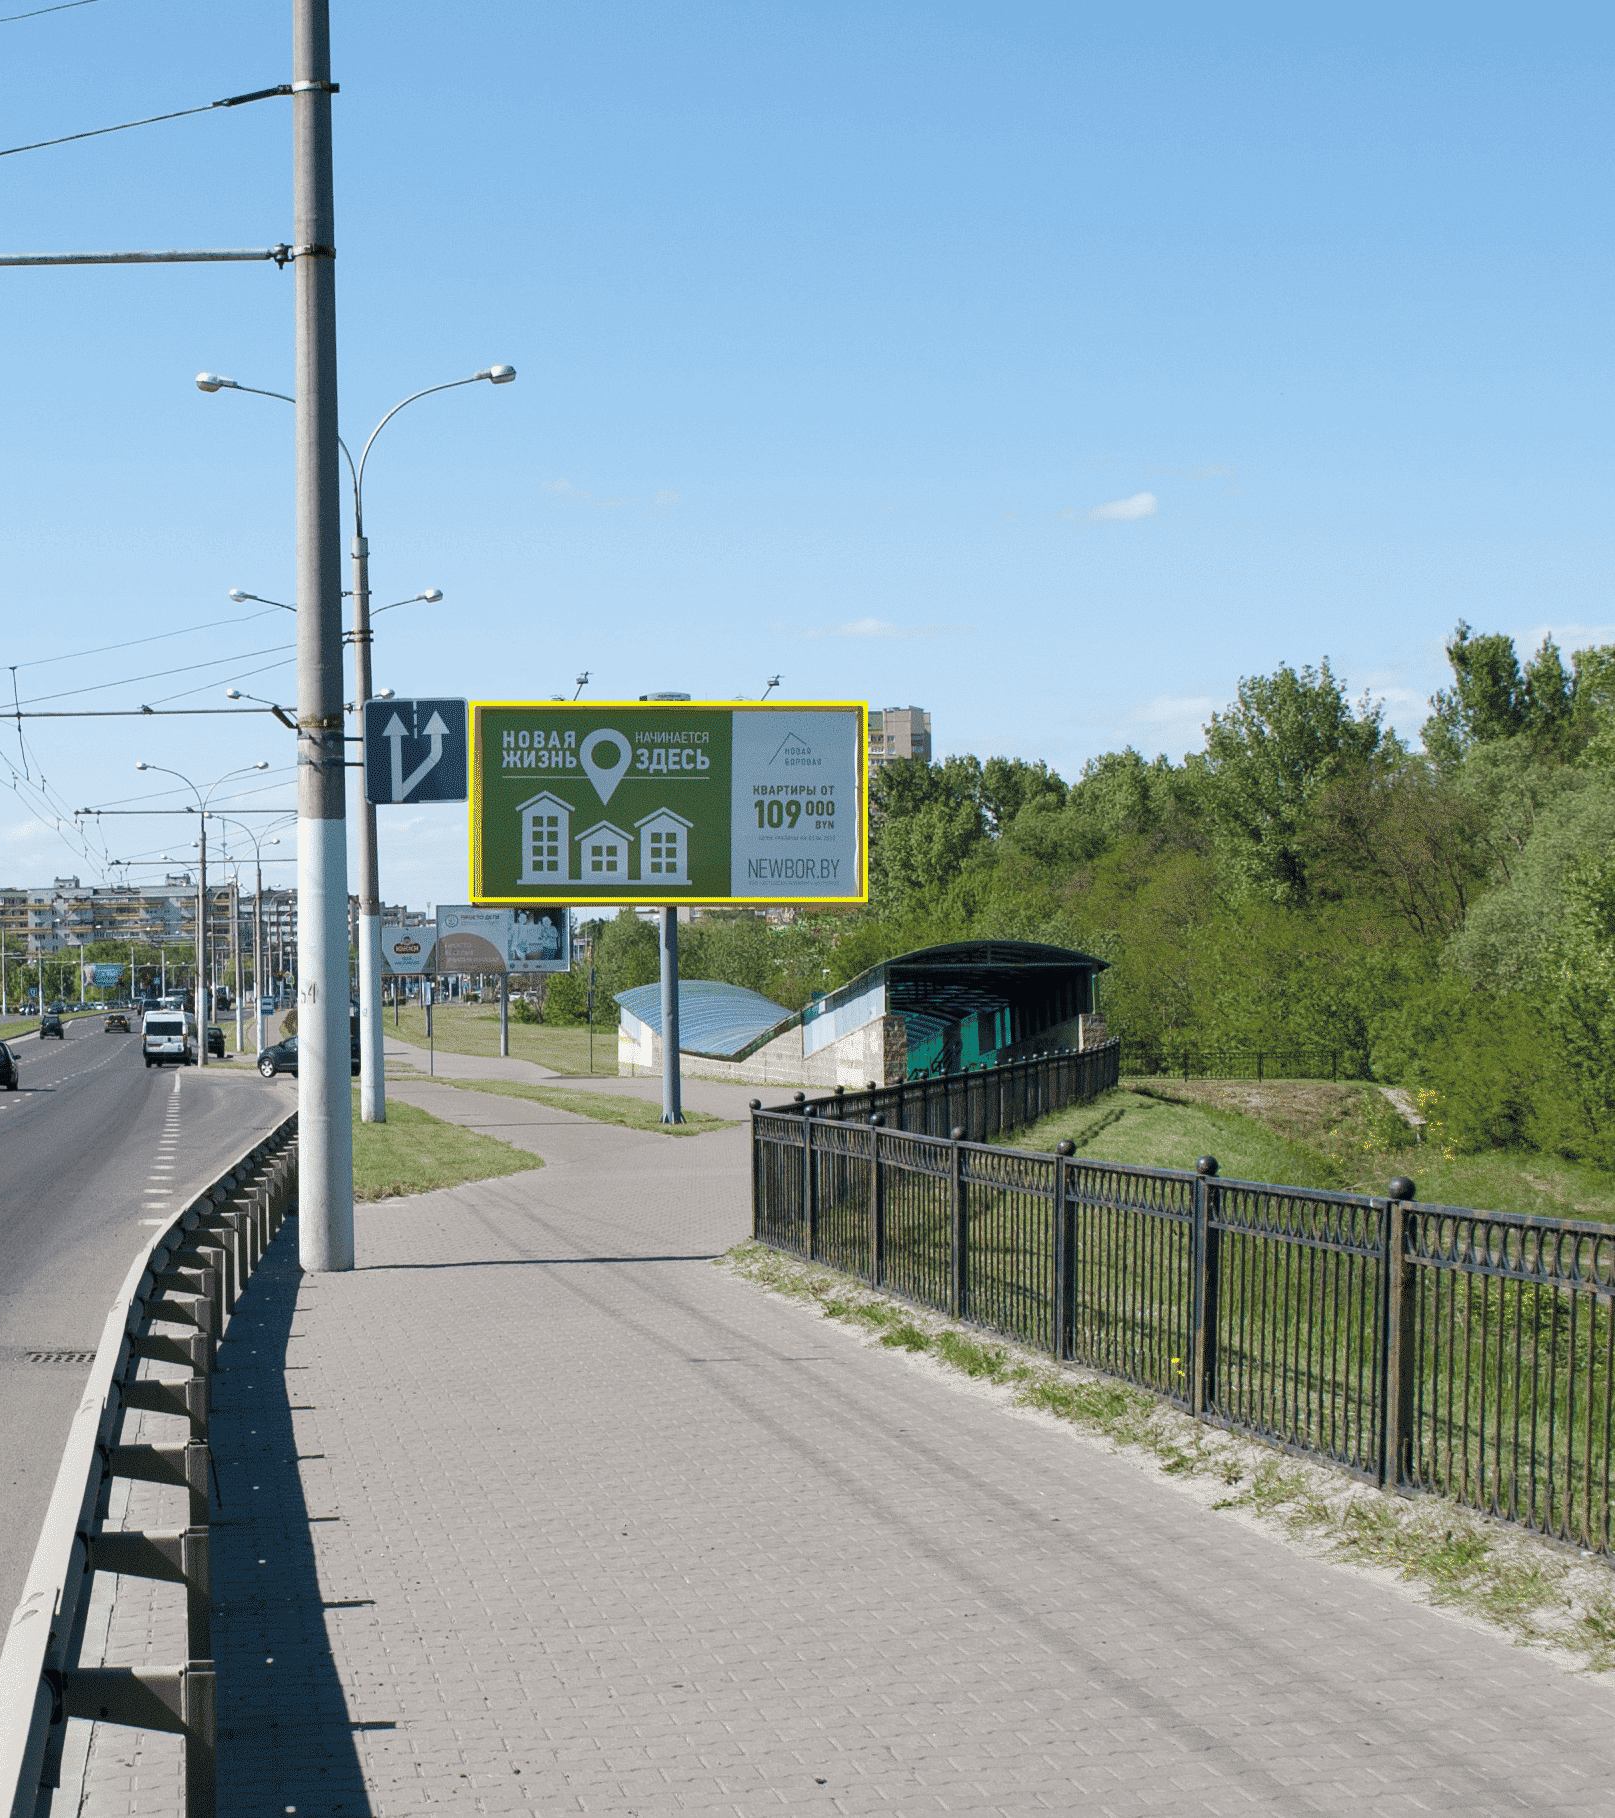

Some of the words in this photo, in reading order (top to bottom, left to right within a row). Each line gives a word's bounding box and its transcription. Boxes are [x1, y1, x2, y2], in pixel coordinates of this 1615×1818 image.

[502, 730, 576, 748] НОВАЯ
[635, 731, 710, 744] НАЧИНАЕТСЯ
[502, 750, 577, 768] ЖИЗНЬ
[635, 748, 710, 774] ЗДЕСЬ
[752, 785, 816, 796] КВАРТИРЫ
[820, 785, 835, 796] ОТ
[754, 799, 802, 829] 109
[805, 800, 835, 816] 000
[814, 820, 835, 829] BYN
[748, 858, 840, 879] NEWBOR.BY
